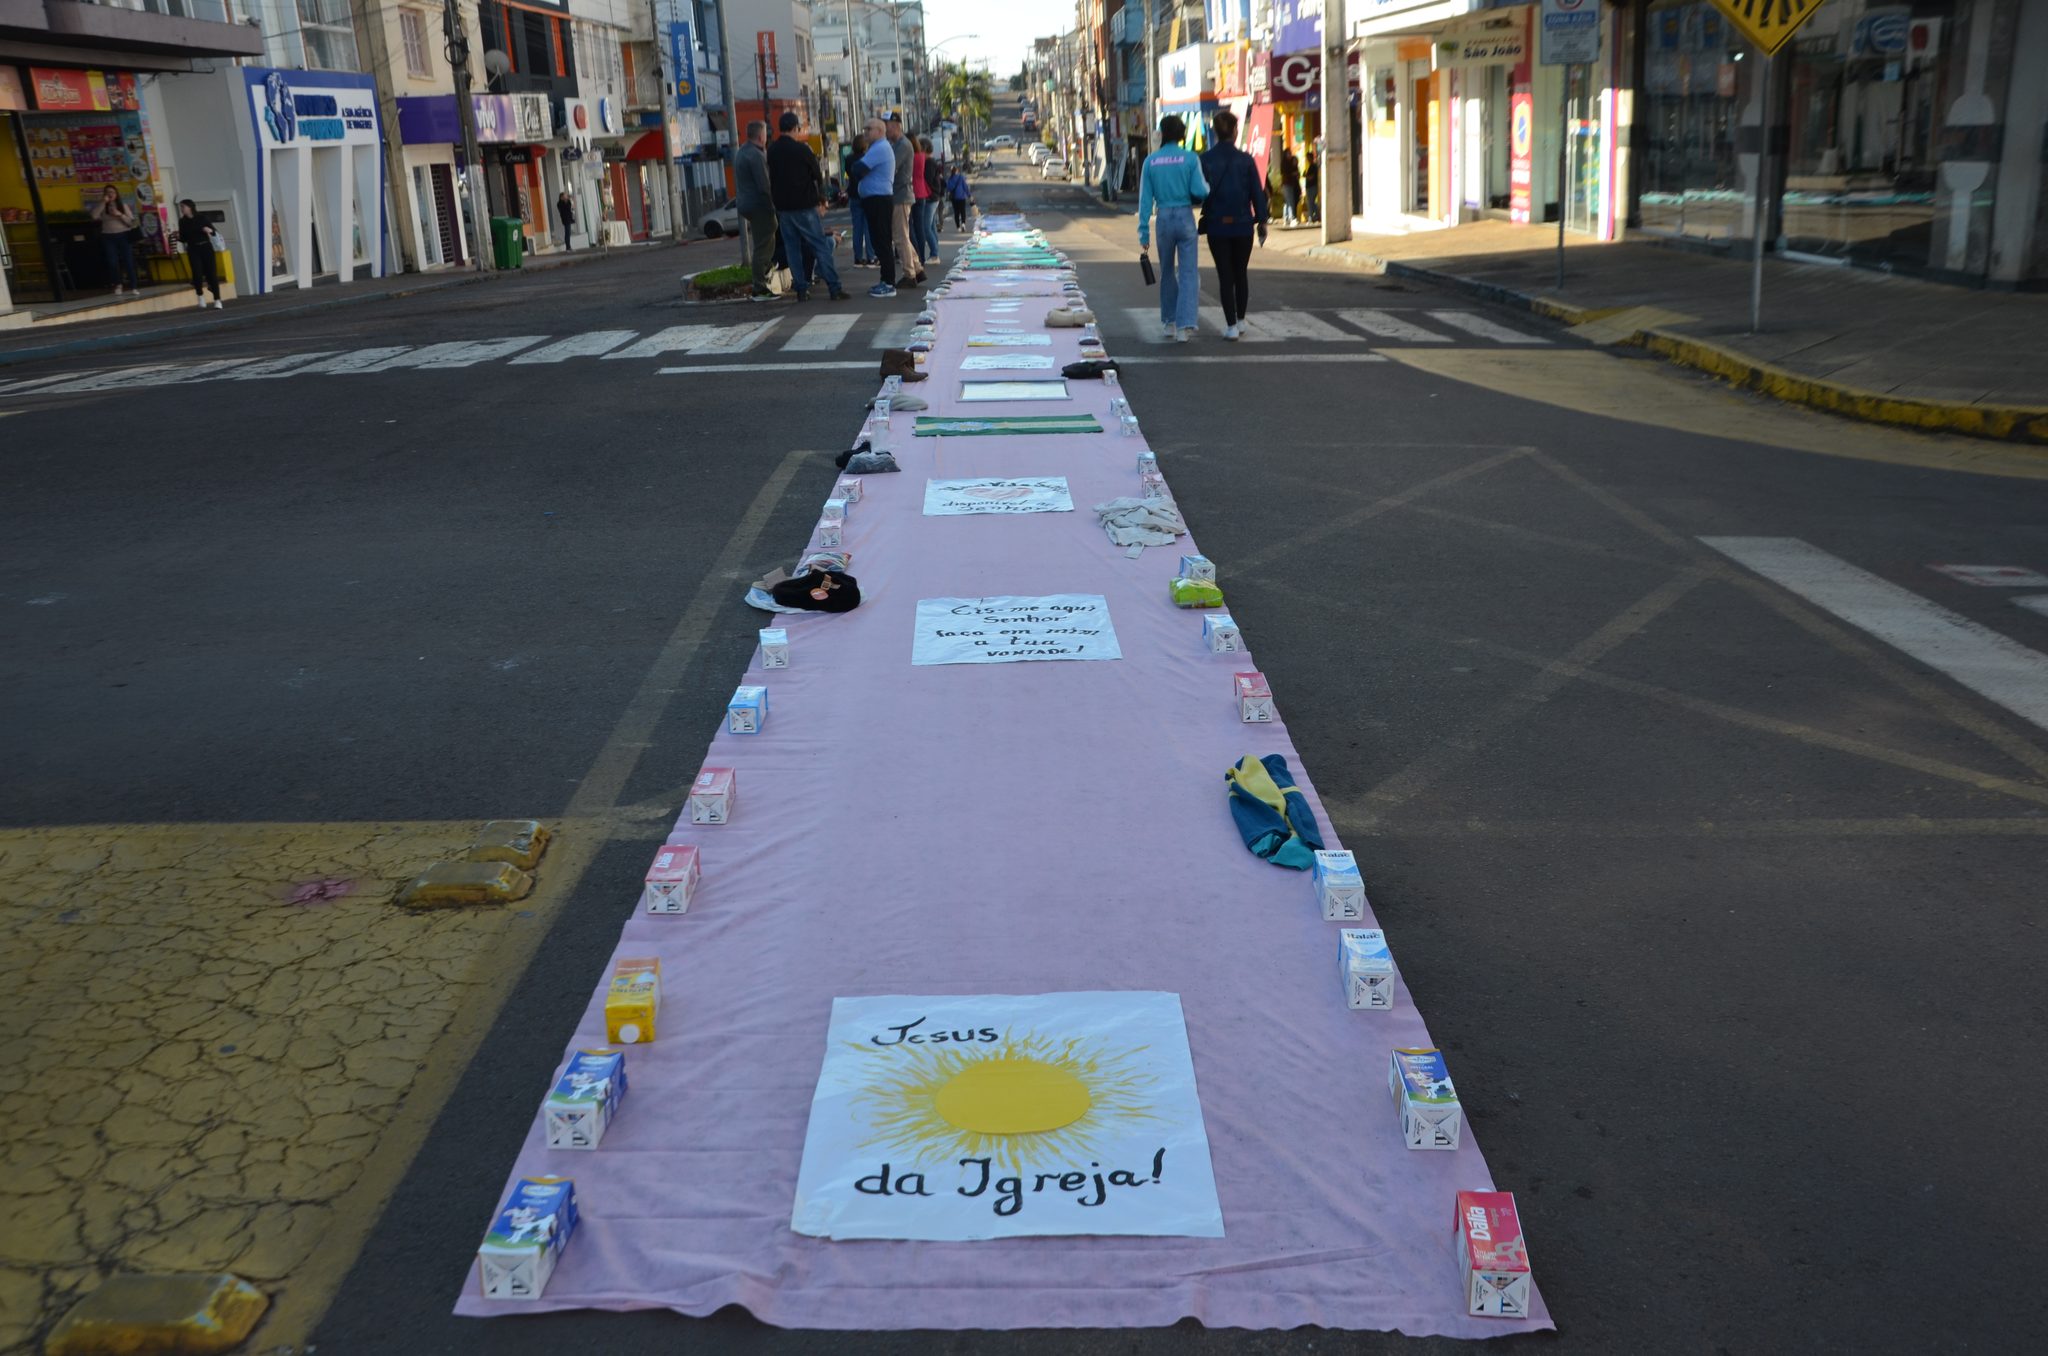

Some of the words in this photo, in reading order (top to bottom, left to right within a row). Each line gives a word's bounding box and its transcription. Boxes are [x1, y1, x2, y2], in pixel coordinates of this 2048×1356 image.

[476, 107, 496, 129] vivo
[1050, 604, 1096, 613] aqui
[983, 614, 1067, 623] Senhor
[1046, 627, 1100, 636] mim
[1010, 636, 1061, 646] tua
[871, 1016, 999, 1046] Jesus
[854, 1163, 935, 1196] da
[957, 1147, 1167, 1217] Igreja!
[1467, 1206, 1491, 1241] Dália
